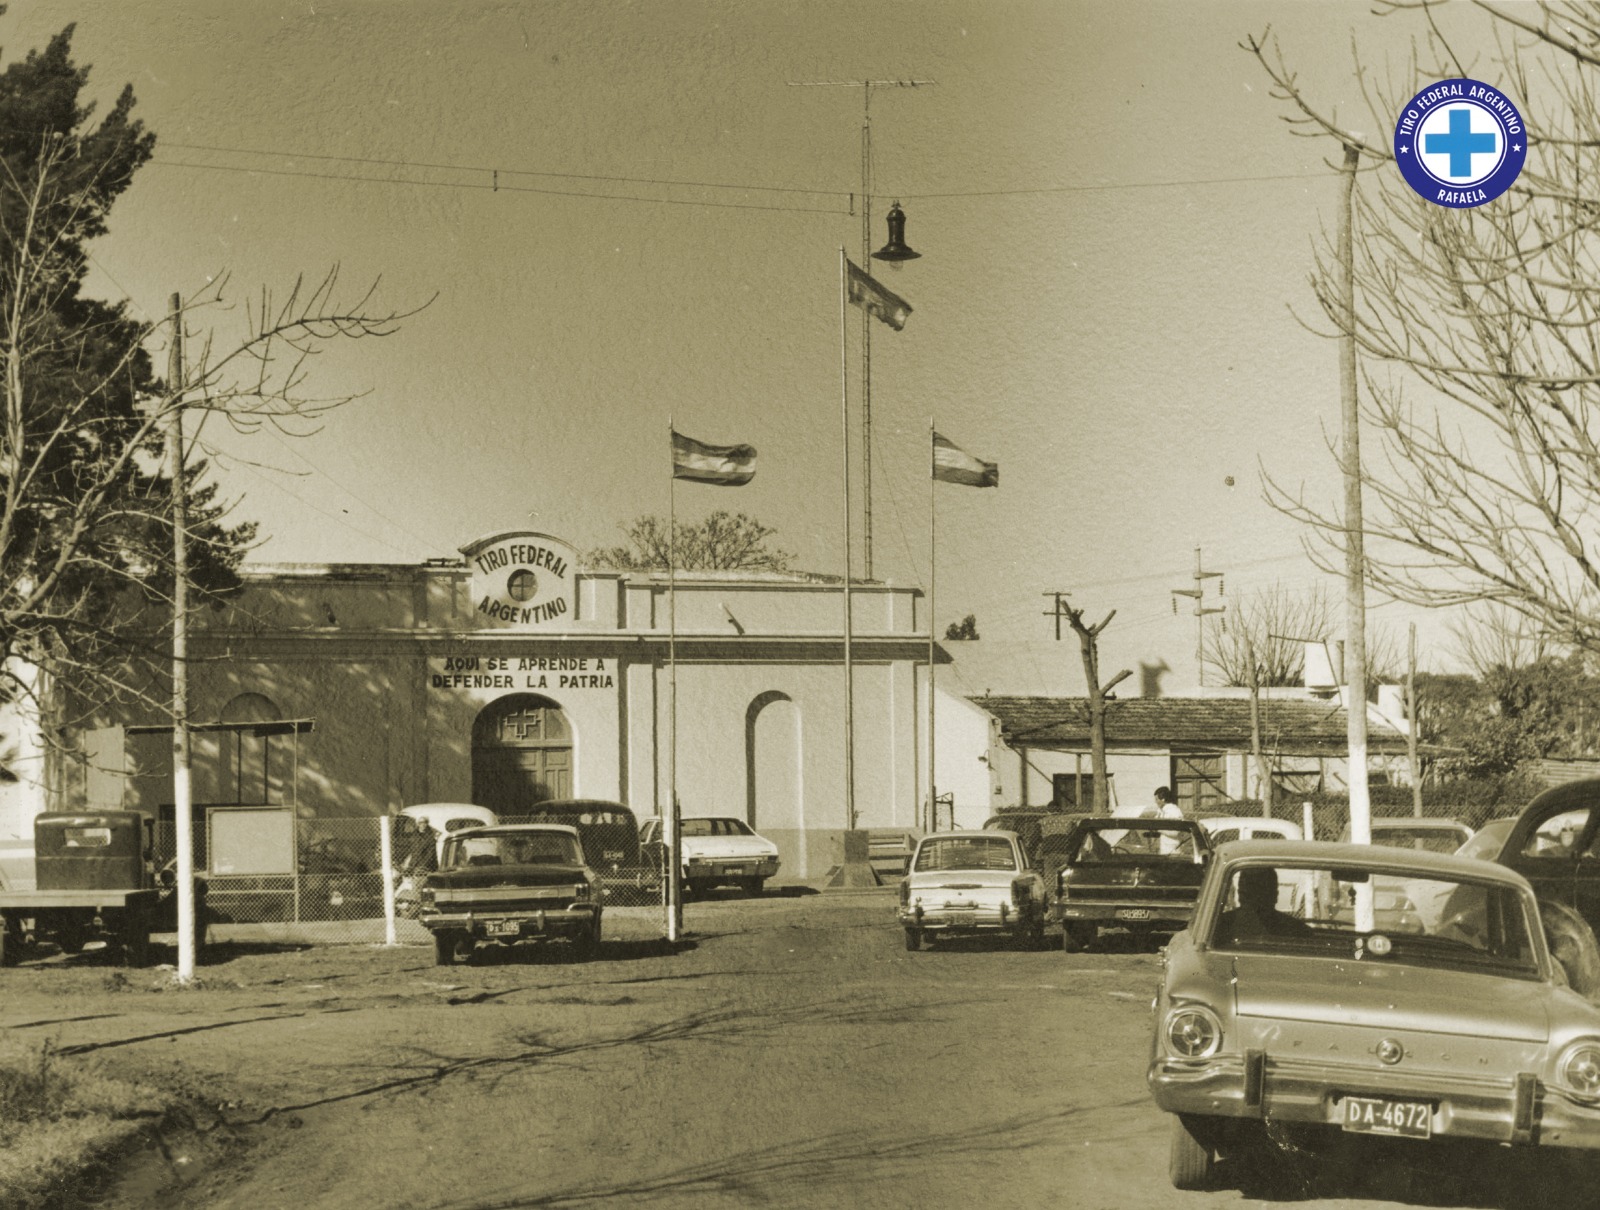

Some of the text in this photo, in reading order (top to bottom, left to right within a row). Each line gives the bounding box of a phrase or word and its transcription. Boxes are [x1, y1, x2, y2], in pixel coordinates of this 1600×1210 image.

[475, 544, 568, 579] TIRO FEDERAL
[478, 595, 567, 624] ARGENTINO
[444, 657, 605, 671] AQUI SE APRENDE A
[432, 675, 614, 688] DEFENDER LA PATRIA
